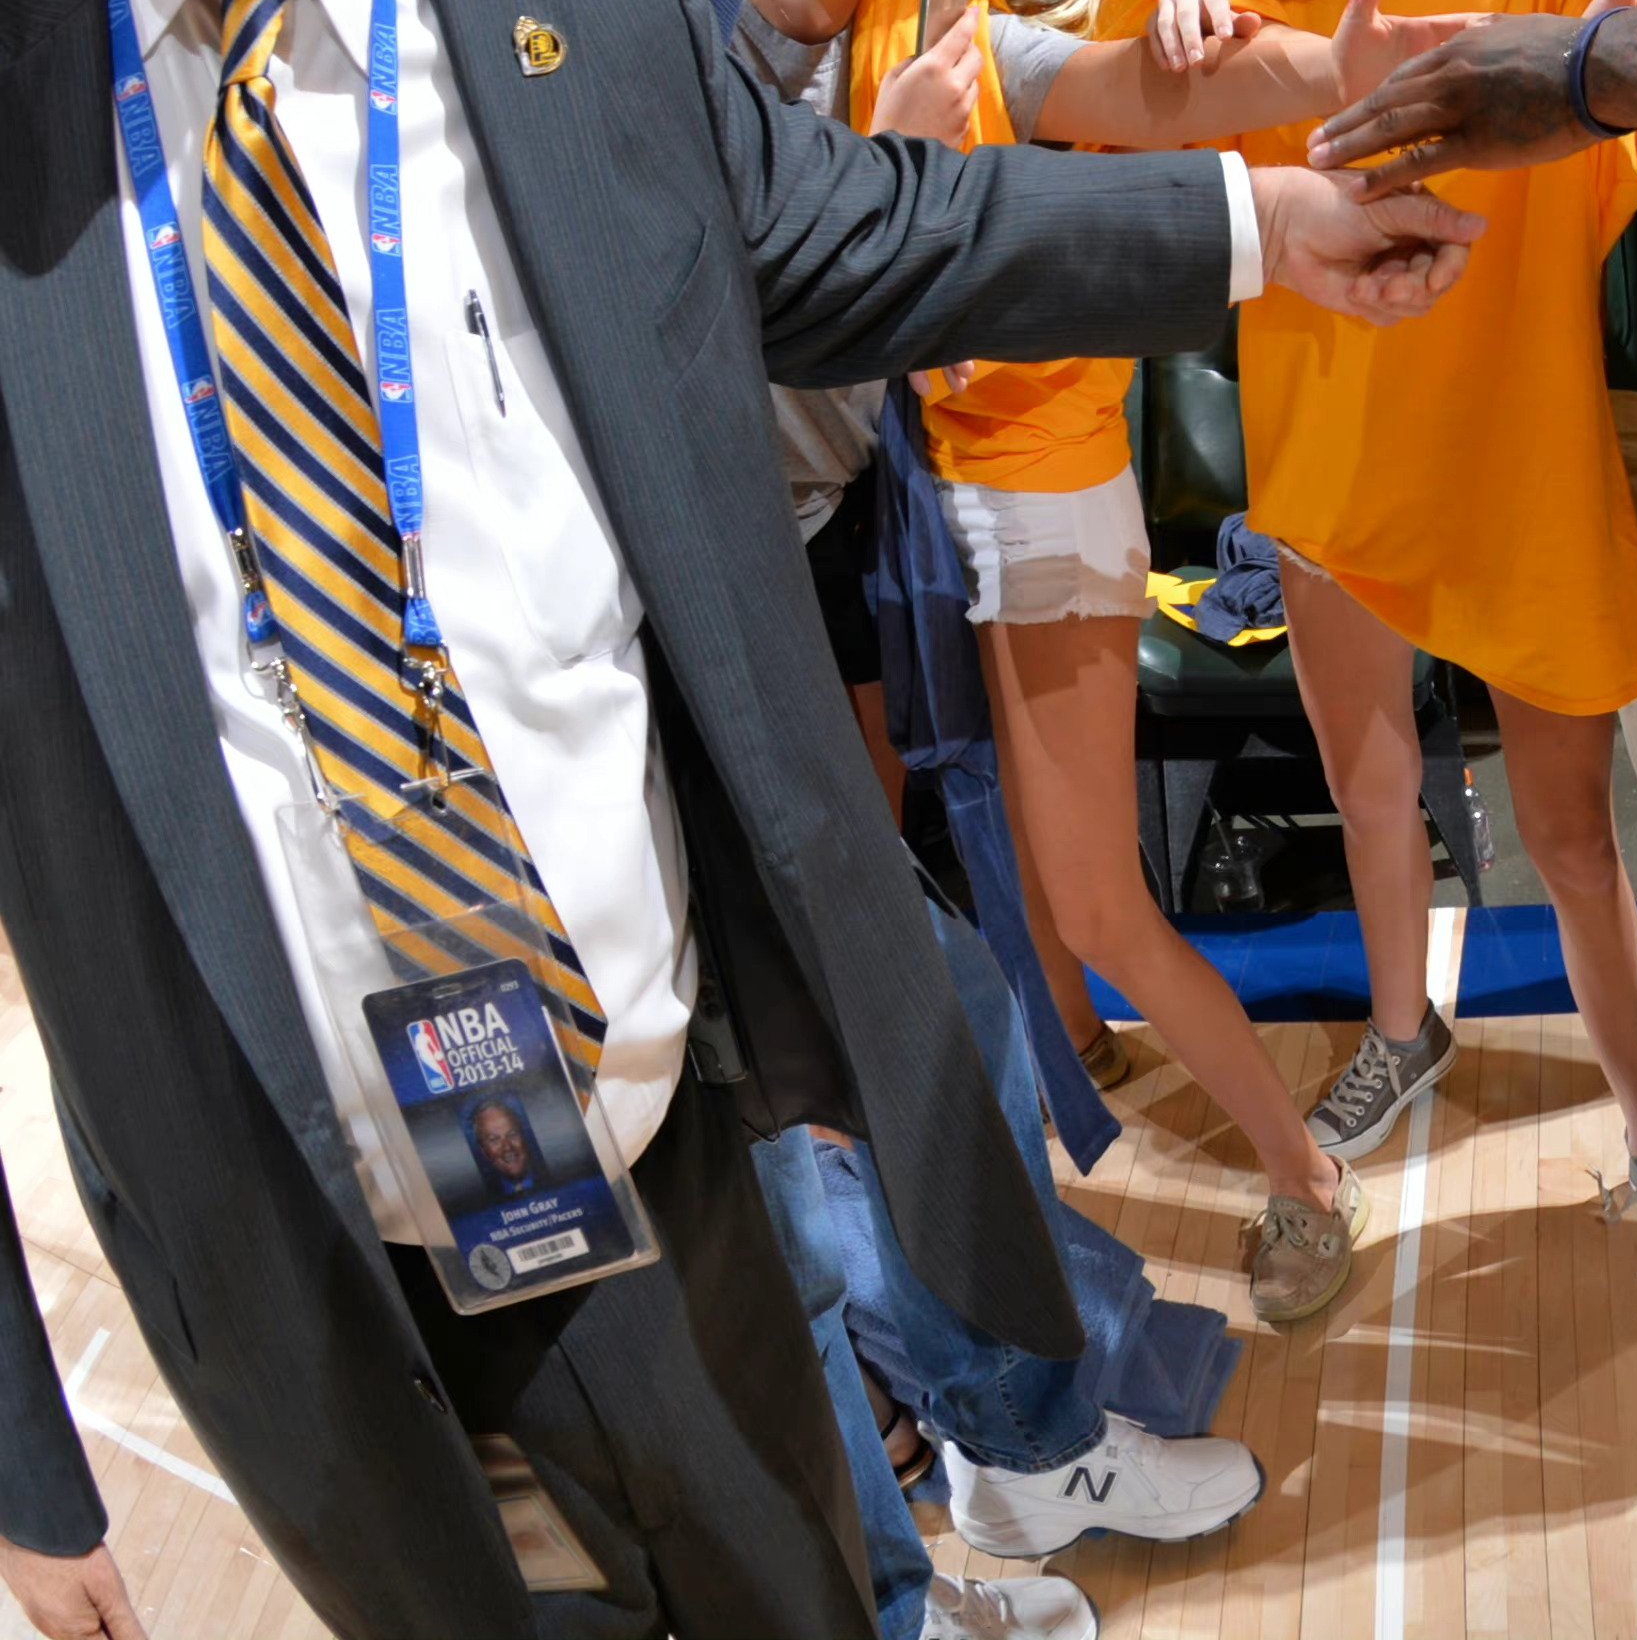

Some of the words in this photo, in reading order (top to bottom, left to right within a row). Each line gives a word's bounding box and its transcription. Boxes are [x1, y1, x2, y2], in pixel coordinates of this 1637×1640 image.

[372, 23, 398, 99] NBA
[121, 95, 161, 177] NBA
[370, 164, 401, 239] NBA
[152, 243, 198, 329] NBA
[377, 307, 411, 385] NBA
[191, 398, 235, 484] NBA
[388, 454, 423, 531] NBA
[434, 1001, 510, 1050] NBA
[447, 1035, 519, 1068] OFFICIAL
[453, 1054, 525, 1088] 2013-14
[1062, 1465, 1118, 1504] N
